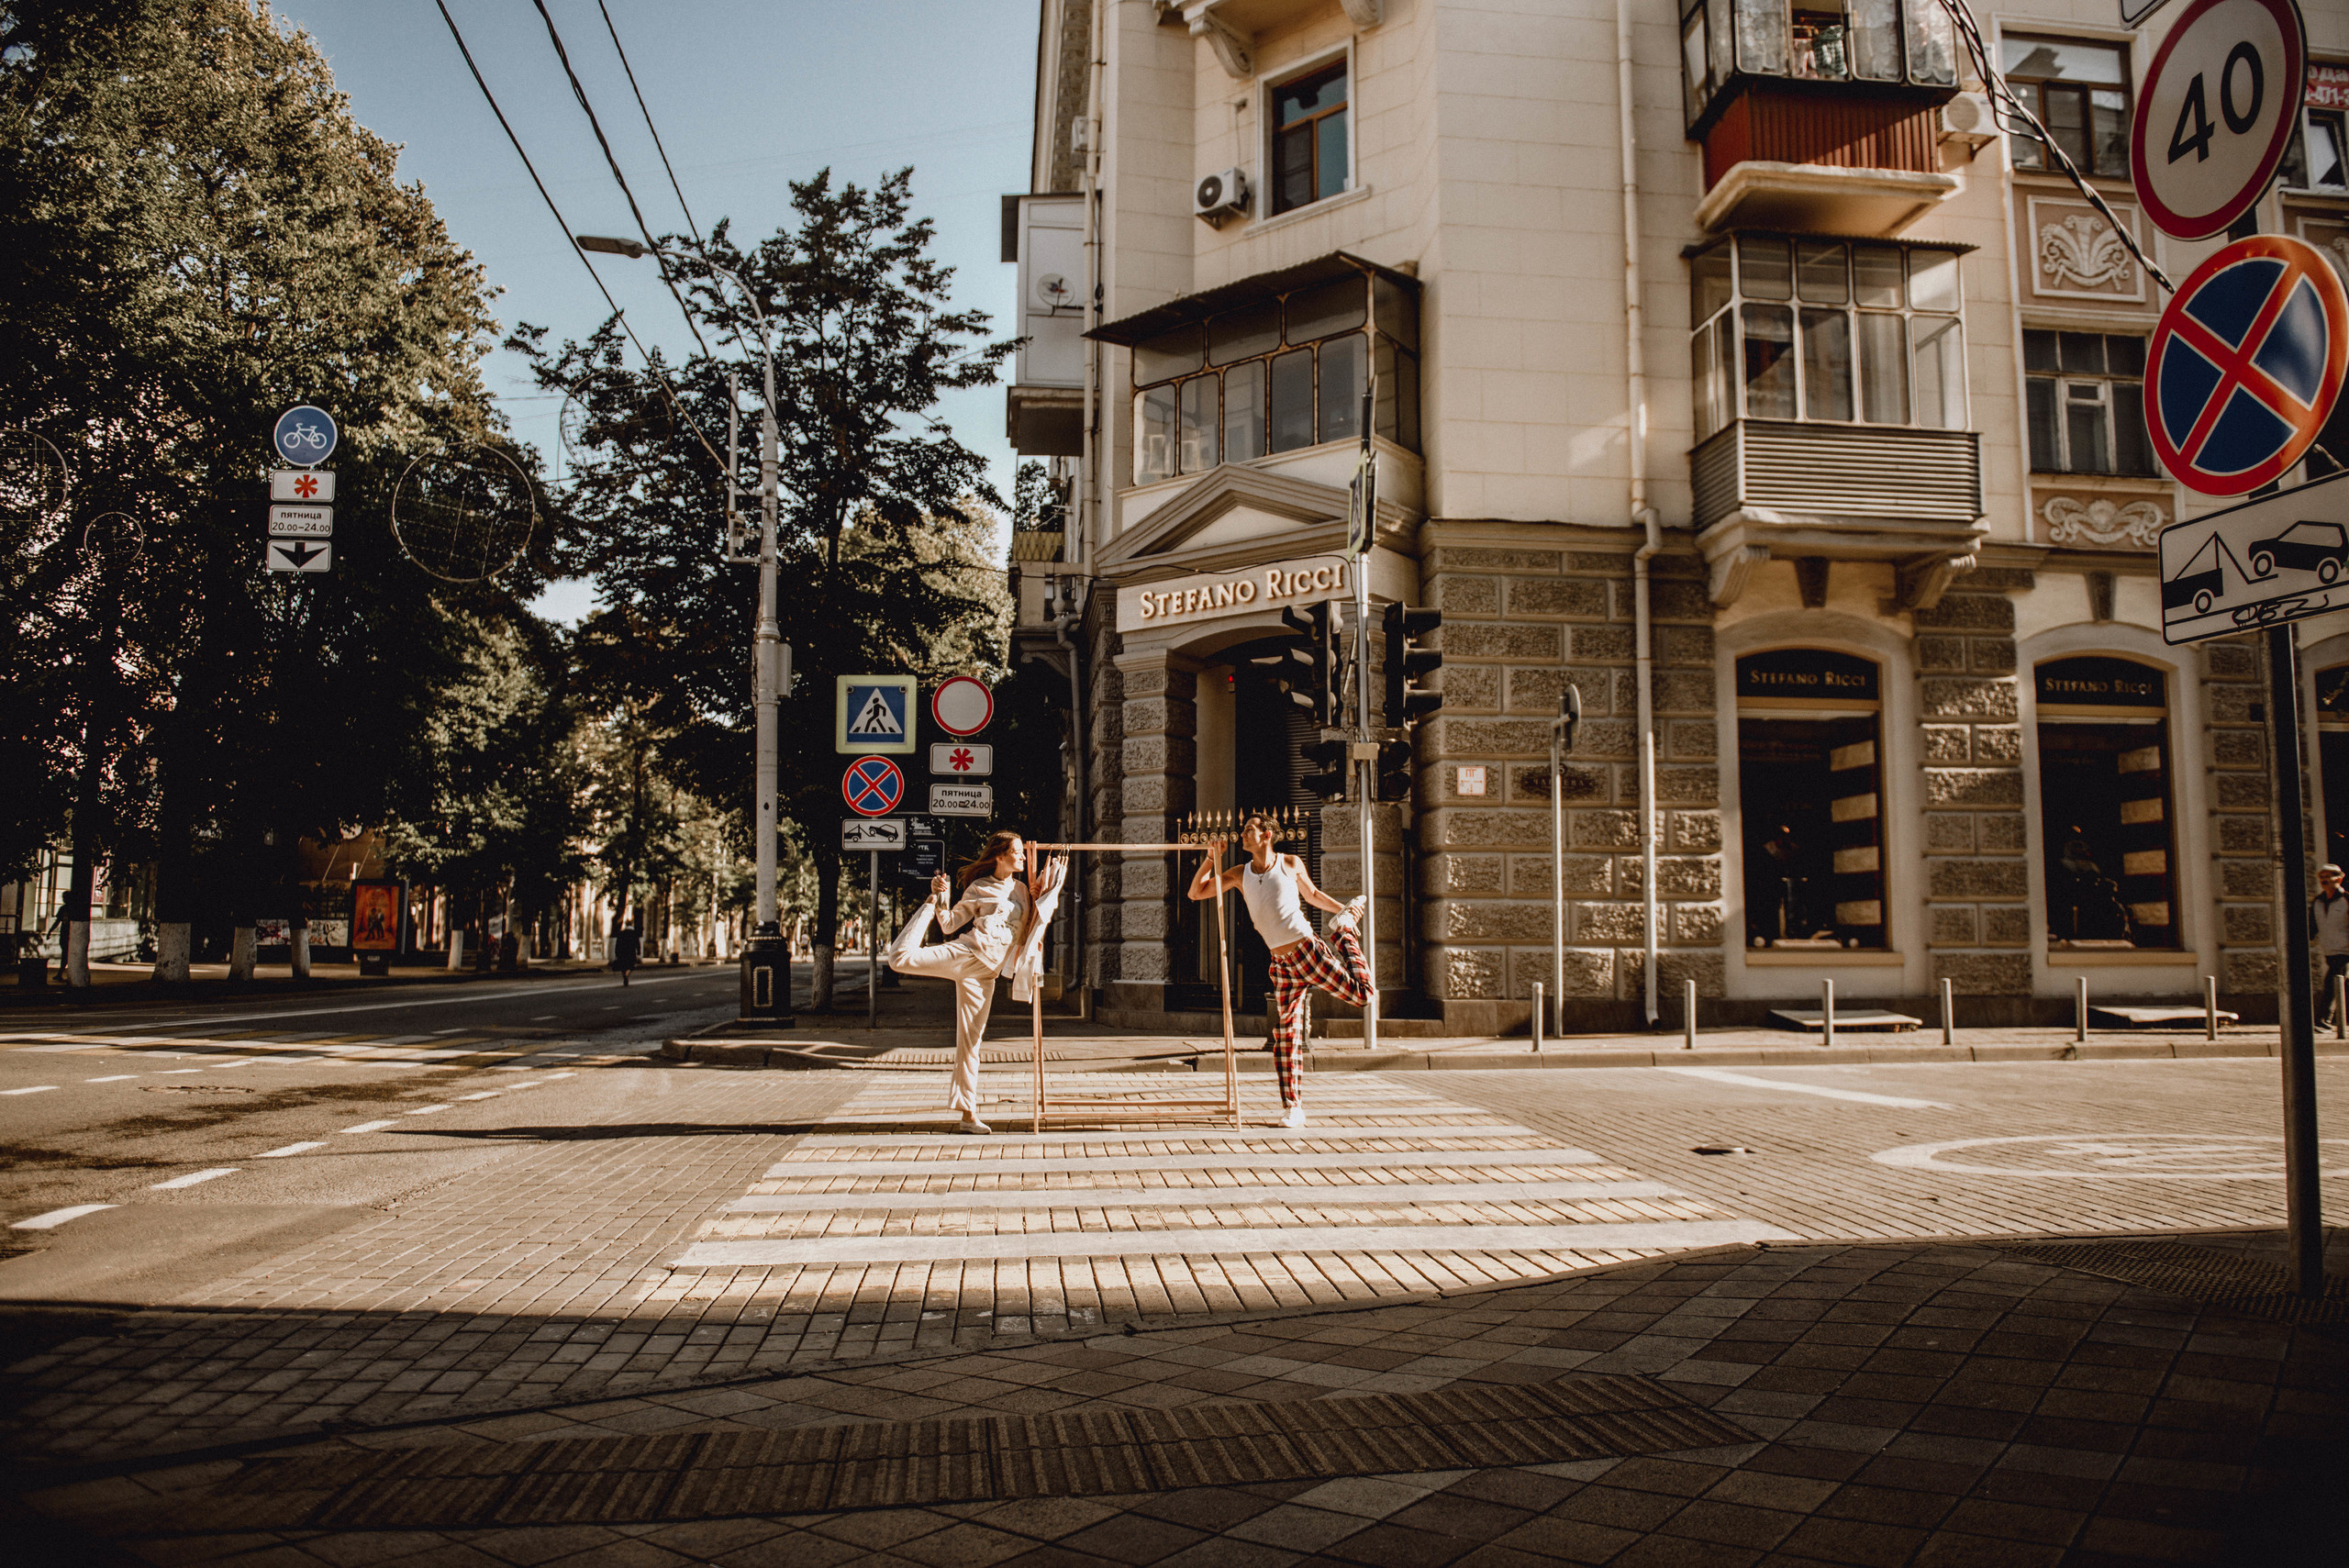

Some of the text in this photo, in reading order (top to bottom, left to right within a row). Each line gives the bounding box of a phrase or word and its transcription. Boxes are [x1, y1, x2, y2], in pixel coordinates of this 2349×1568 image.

[2167, 40, 2264, 165] 40
[281, 511, 322, 520] пятница
[1140, 563, 1345, 619] STEFANO RICCI
[1750, 669, 1865, 686] STEFANO RICCI
[2045, 677, 2153, 695] STEFANO RICCI
[941, 790, 982, 798] пятница
[932, 799, 990, 809] 20.0024.00
